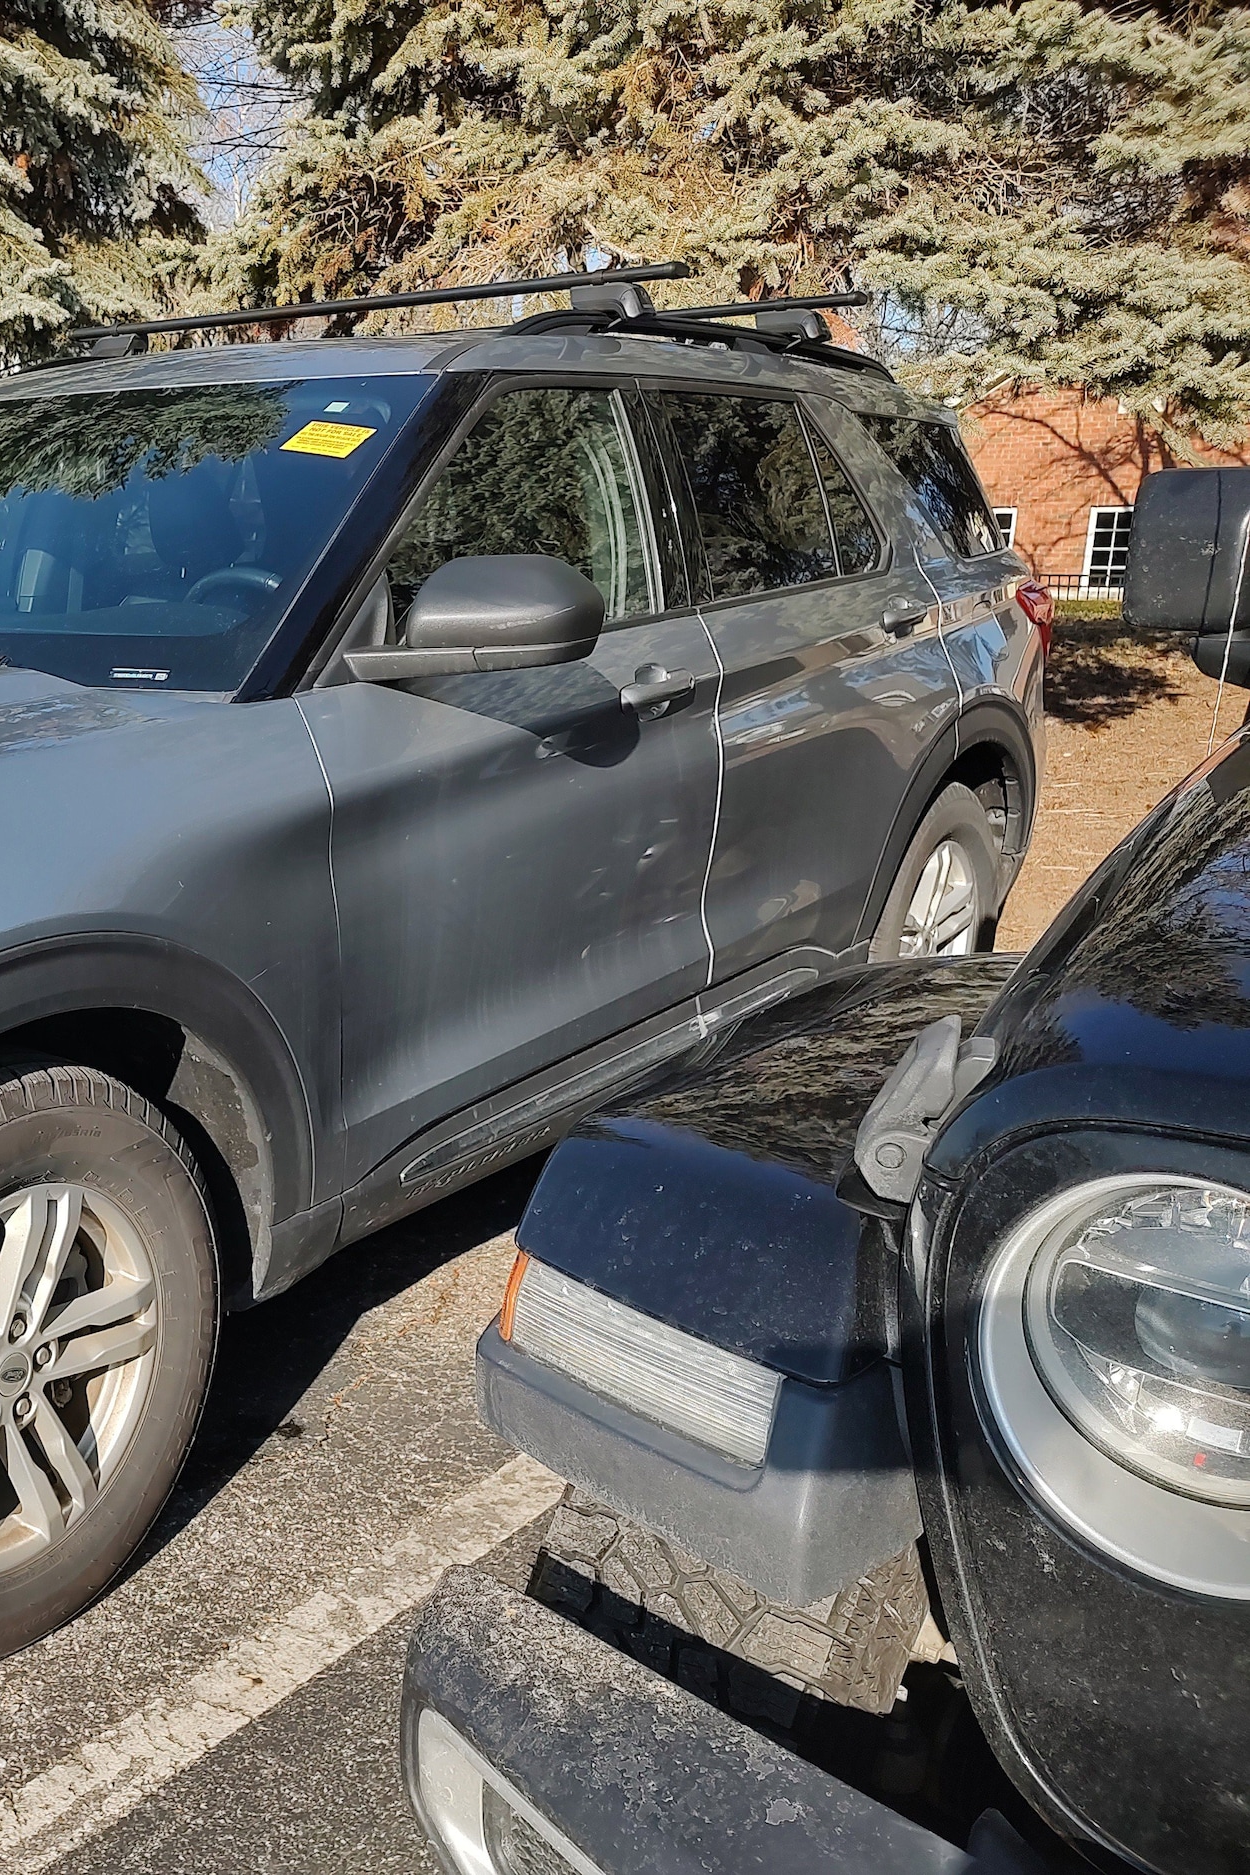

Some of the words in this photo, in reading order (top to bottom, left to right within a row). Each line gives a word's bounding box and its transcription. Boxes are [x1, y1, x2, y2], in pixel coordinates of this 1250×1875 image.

[330, 424, 363, 433] VEHICLE
[404, 1125, 551, 1201] EXPLORER
[167, 1235, 212, 1470] COOPER
